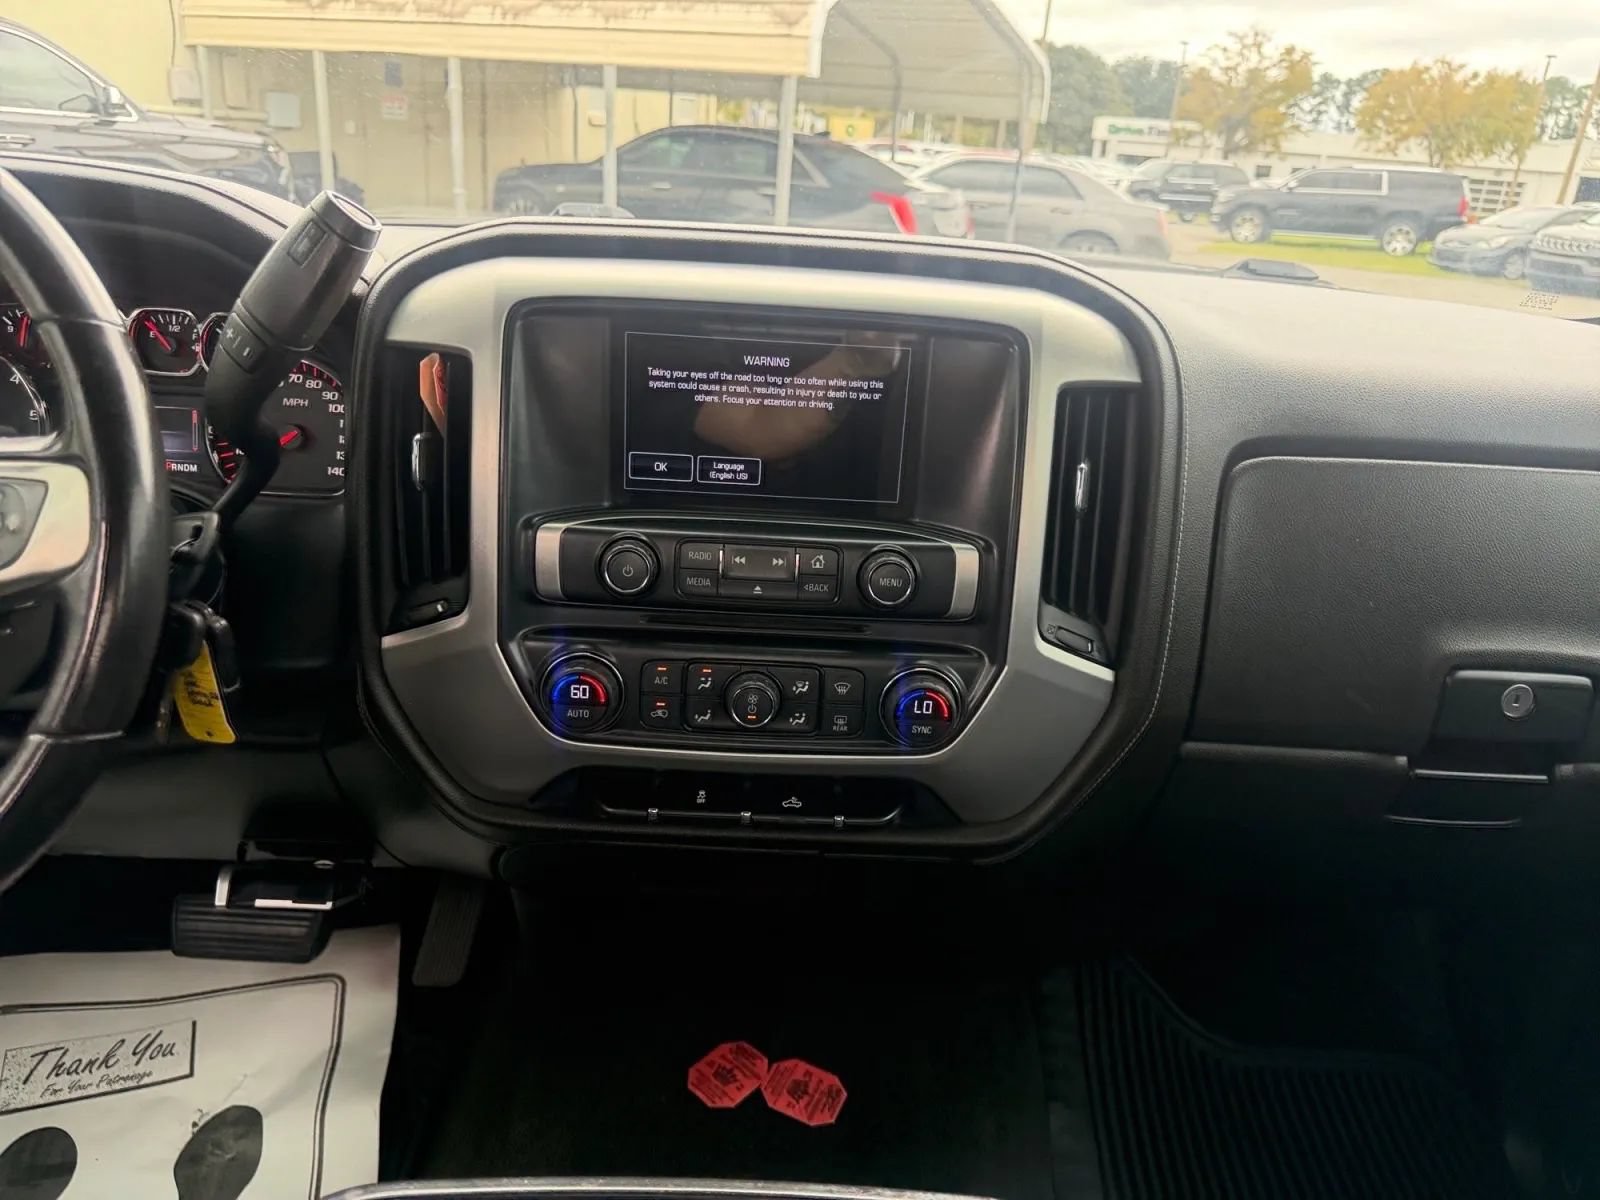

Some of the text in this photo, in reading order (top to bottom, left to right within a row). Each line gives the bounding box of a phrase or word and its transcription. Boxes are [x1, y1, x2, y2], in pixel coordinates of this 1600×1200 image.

[744, 355, 790, 368] WARNING
[9, 374, 20, 384] 4
[288, 374, 303, 383] 70
[648, 367, 671, 378] Taking
[672, 370, 689, 379] your
[690, 372, 707, 380] eyes
[709, 371, 719, 379] off
[720, 372, 733, 380] the
[734, 374, 752, 382] road
[767, 375, 783, 385] long
[794, 377, 806, 385] too
[807, 377, 827, 386] often
[828, 378, 847, 388] while
[848, 380, 869, 390] using
[869, 380, 884, 389] this
[305, 380, 322, 389] 80
[648, 380, 676, 389] system
[677, 381, 698, 390] could
[698, 383, 720, 391] cause
[728, 384, 752, 393] crash,
[753, 386, 786, 396] resulting
[787, 387, 794, 396] in
[795, 387, 816, 398] injury
[827, 389, 848, 398] death
[849, 391, 857, 399] to
[858, 392, 872, 401] you
[321, 391, 339, 401] 90
[282, 398, 309, 407] MPH
[694, 394, 836, 411] others. Focus your attention on driving.
[29, 410, 39, 420] 5
[165, 461, 198, 472] PRNDM
[654, 462, 668, 472] OK
[713, 462, 745, 471] Language
[709, 471, 735, 480] (English
[688, 551, 712, 561] RADIO
[686, 576, 711, 587] MEDIA
[879, 577, 903, 588] MENU
[654, 676, 668, 685] A/C
[914, 700, 933, 714] LO
[567, 709, 589, 719] AUTO
[911, 725, 932, 735] SYNC
[22, 1029, 176, 1085] Thank You
[40, 1070, 153, 1098] For Your Patronage
